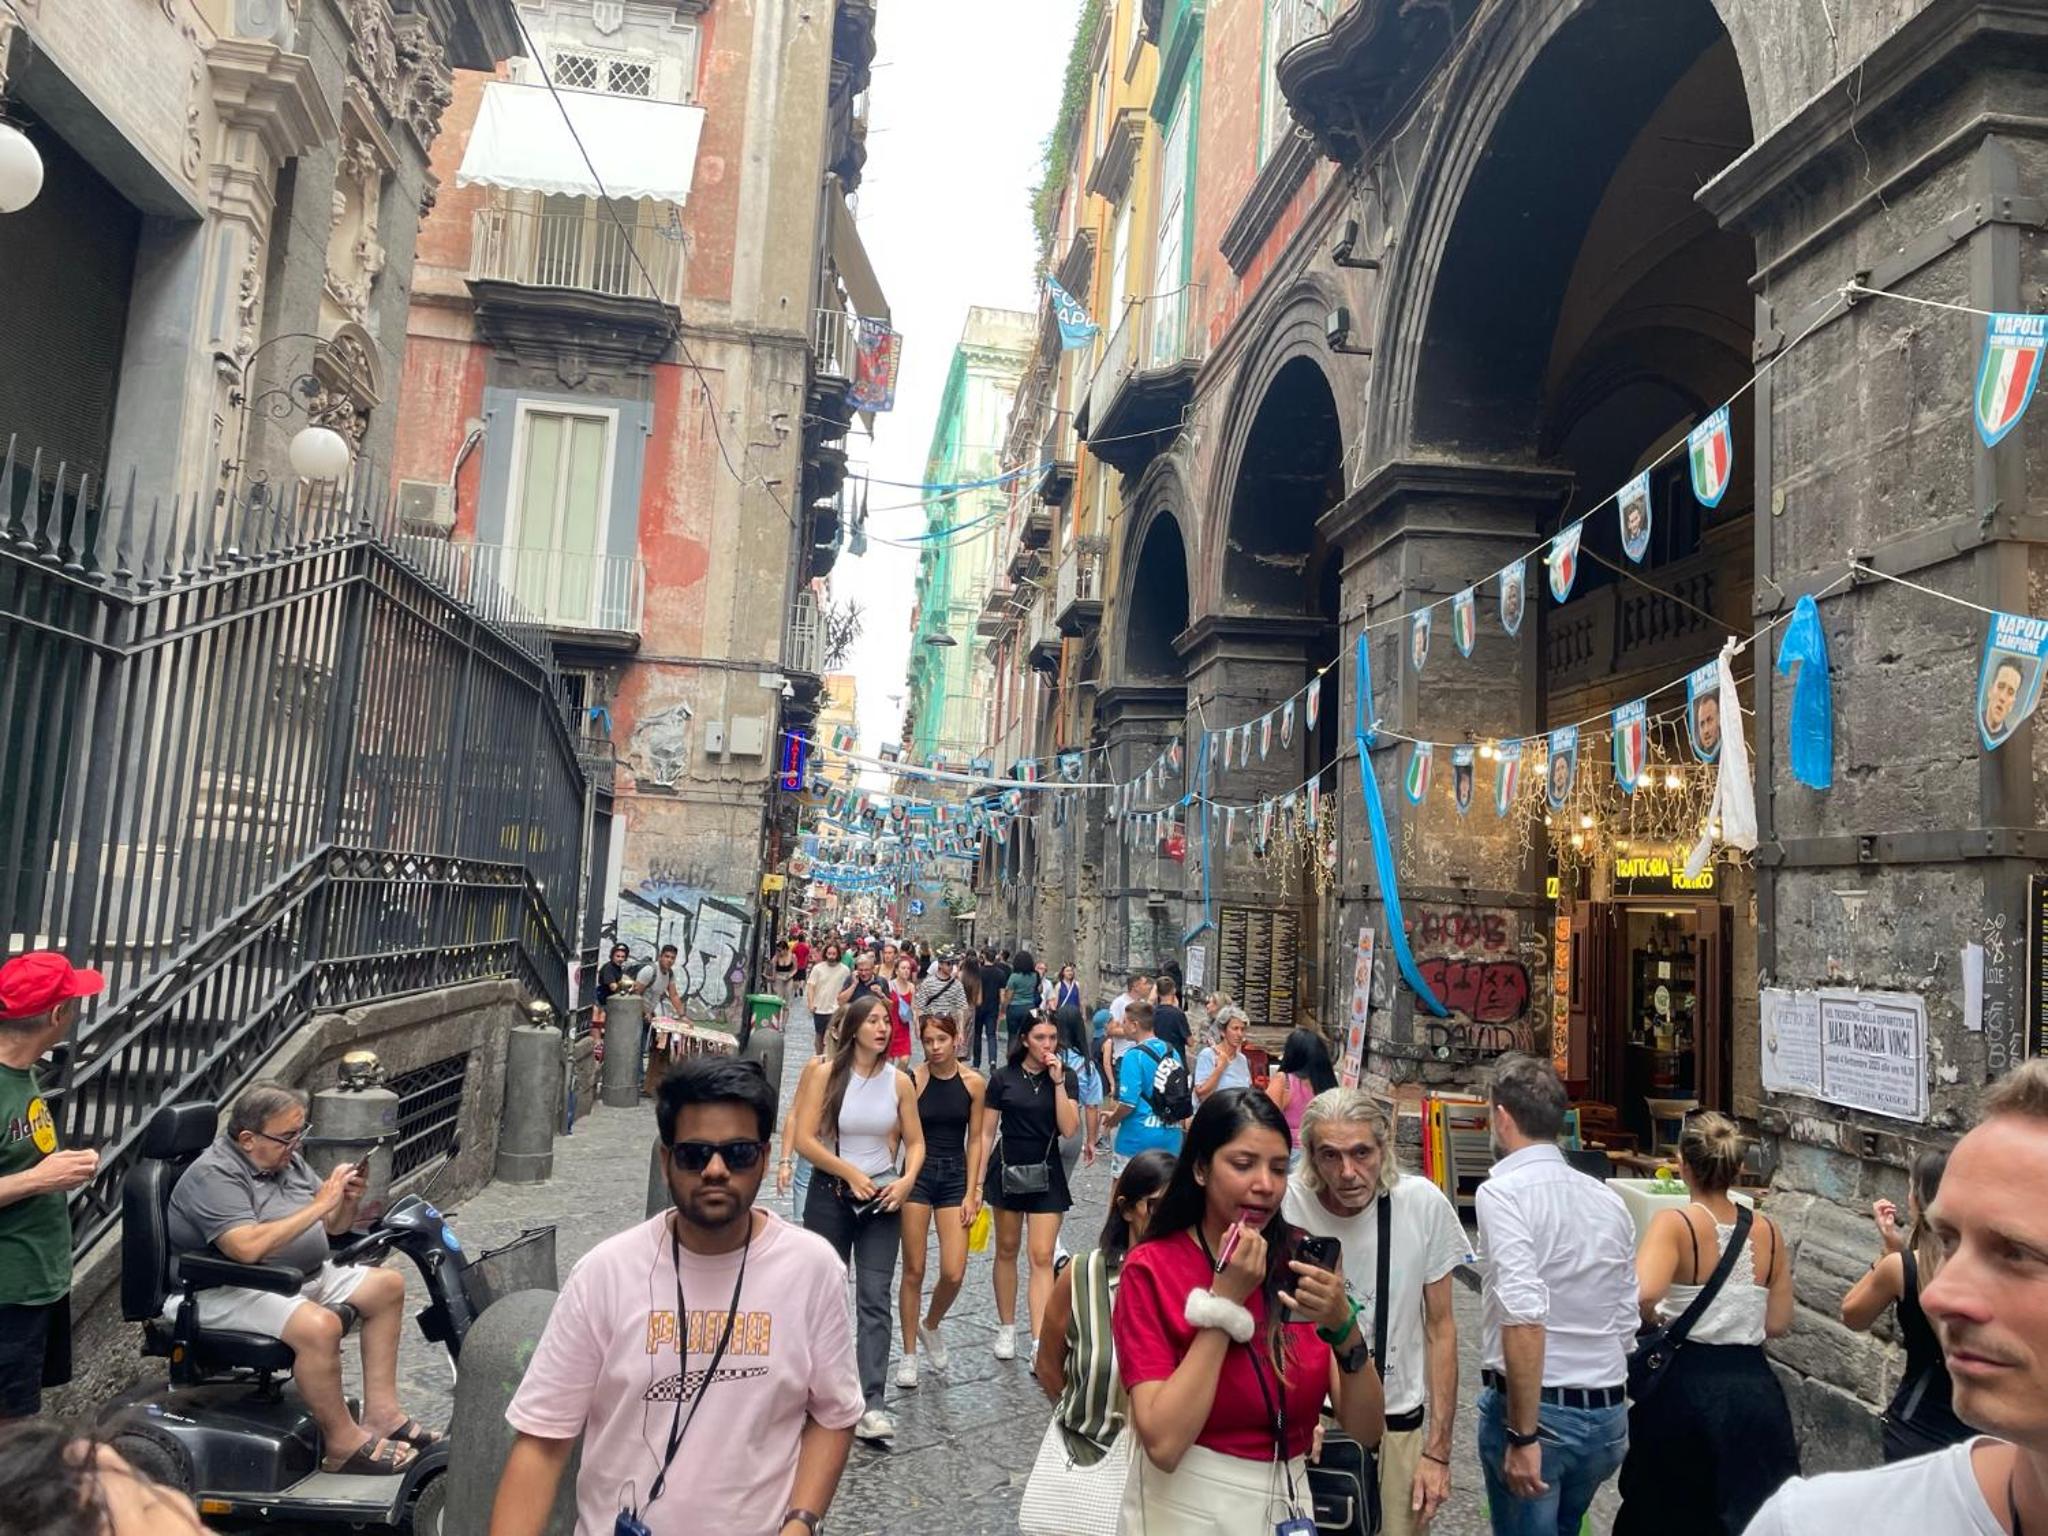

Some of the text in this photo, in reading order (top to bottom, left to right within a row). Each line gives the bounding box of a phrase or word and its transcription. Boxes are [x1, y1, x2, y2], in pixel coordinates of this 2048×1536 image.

[1995, 316, 2044, 335] NAPOLI
[1996, 615, 2048, 640] NAPOLI
[1995, 632, 2040, 654] CAMPIONE
[1692, 661, 1719, 682] NAPOL
[1615, 857, 1670, 877] TRATTORIA
[1829, 1021, 1850, 1047] MARIA
[1854, 1024, 1885, 1053] ROSARIA
[646, 1310, 772, 1356] PUMA
